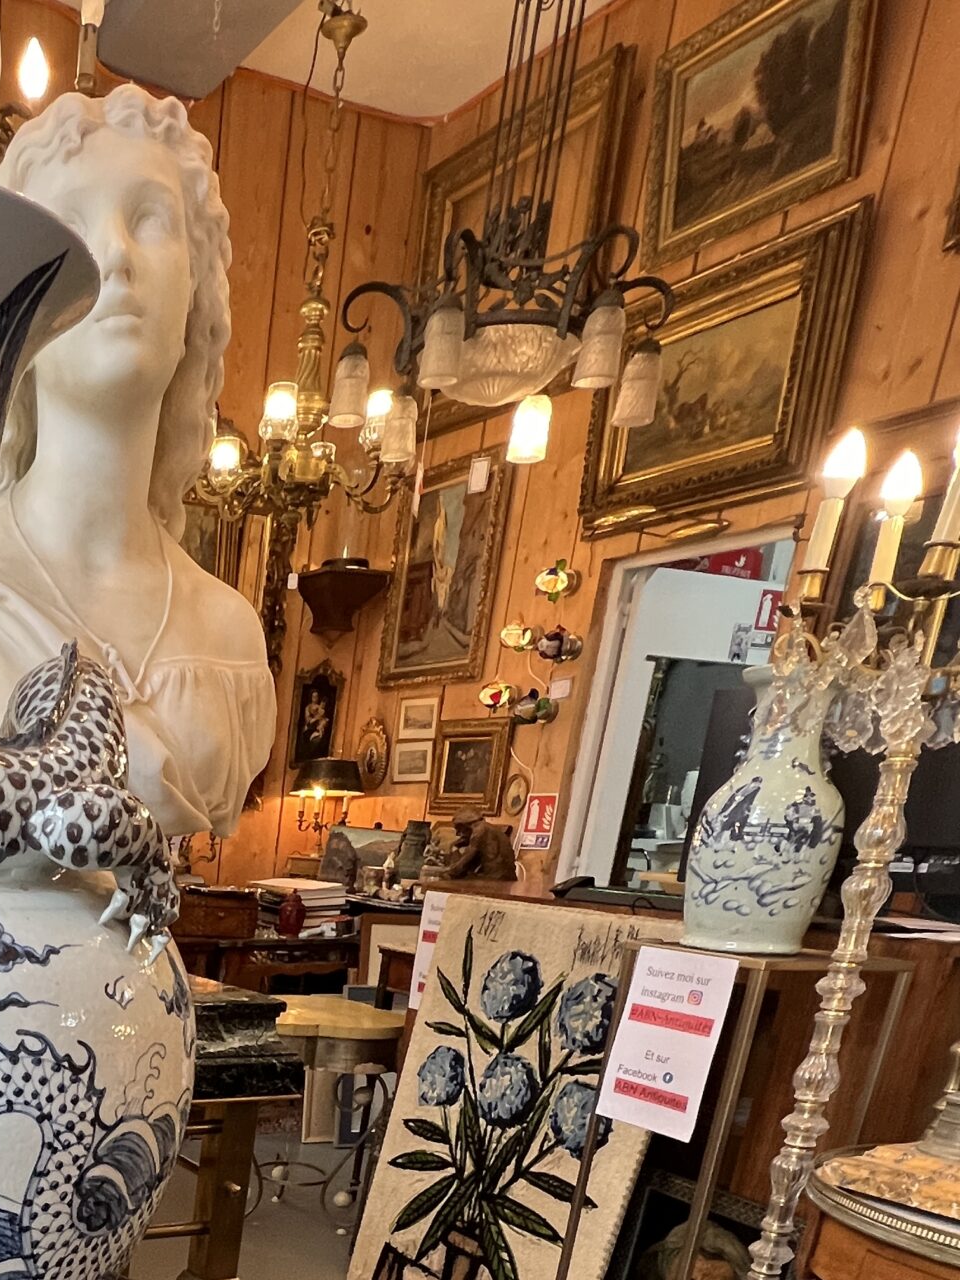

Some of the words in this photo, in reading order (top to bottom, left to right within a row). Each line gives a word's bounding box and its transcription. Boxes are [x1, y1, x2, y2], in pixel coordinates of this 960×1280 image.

[646, 966, 675, 980] Suivez
[676, 973, 695, 983] moi
[696, 976, 712, 986] sur
[644, 1050, 655, 1060] Et
[655, 1055, 671, 1064] sur
[617, 1063, 657, 1082] Facebook
[615, 1080, 638, 1095] ABN
